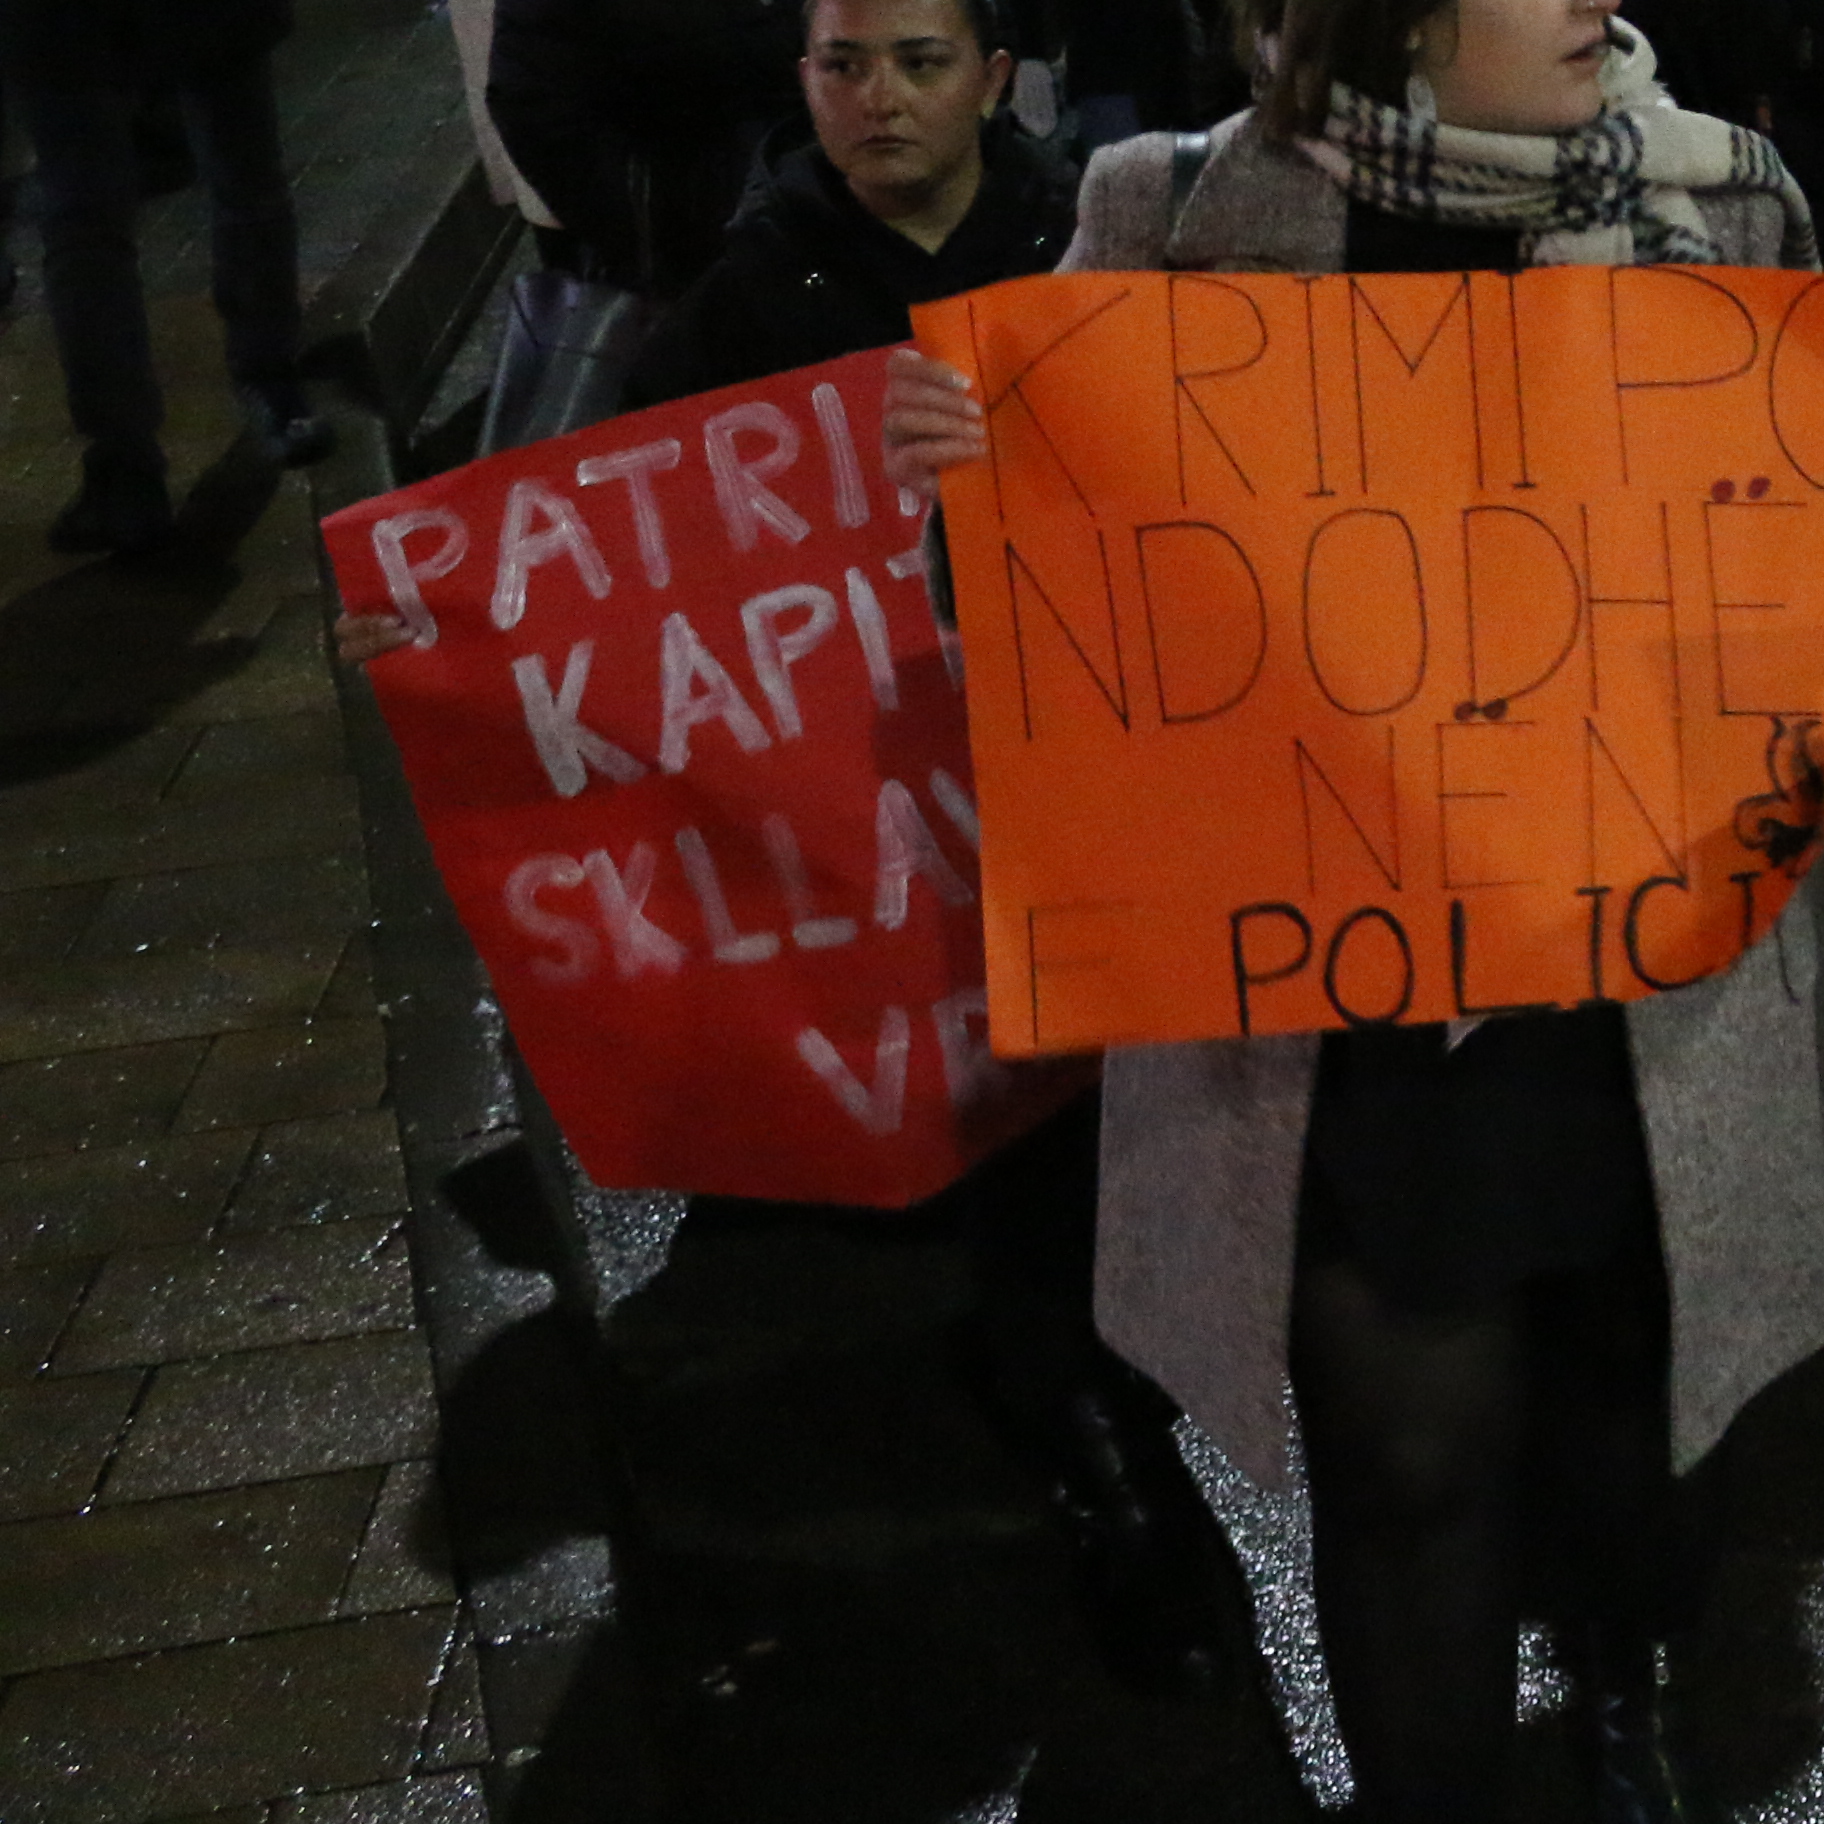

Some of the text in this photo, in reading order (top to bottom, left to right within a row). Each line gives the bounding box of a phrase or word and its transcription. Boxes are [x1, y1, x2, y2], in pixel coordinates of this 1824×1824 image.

[373, 382, 915, 649] PATRI
[968, 270, 1539, 523] KRIMI
[1003, 476, 1824, 741] NDODHË
[1295, 697, 1691, 898] NËN
